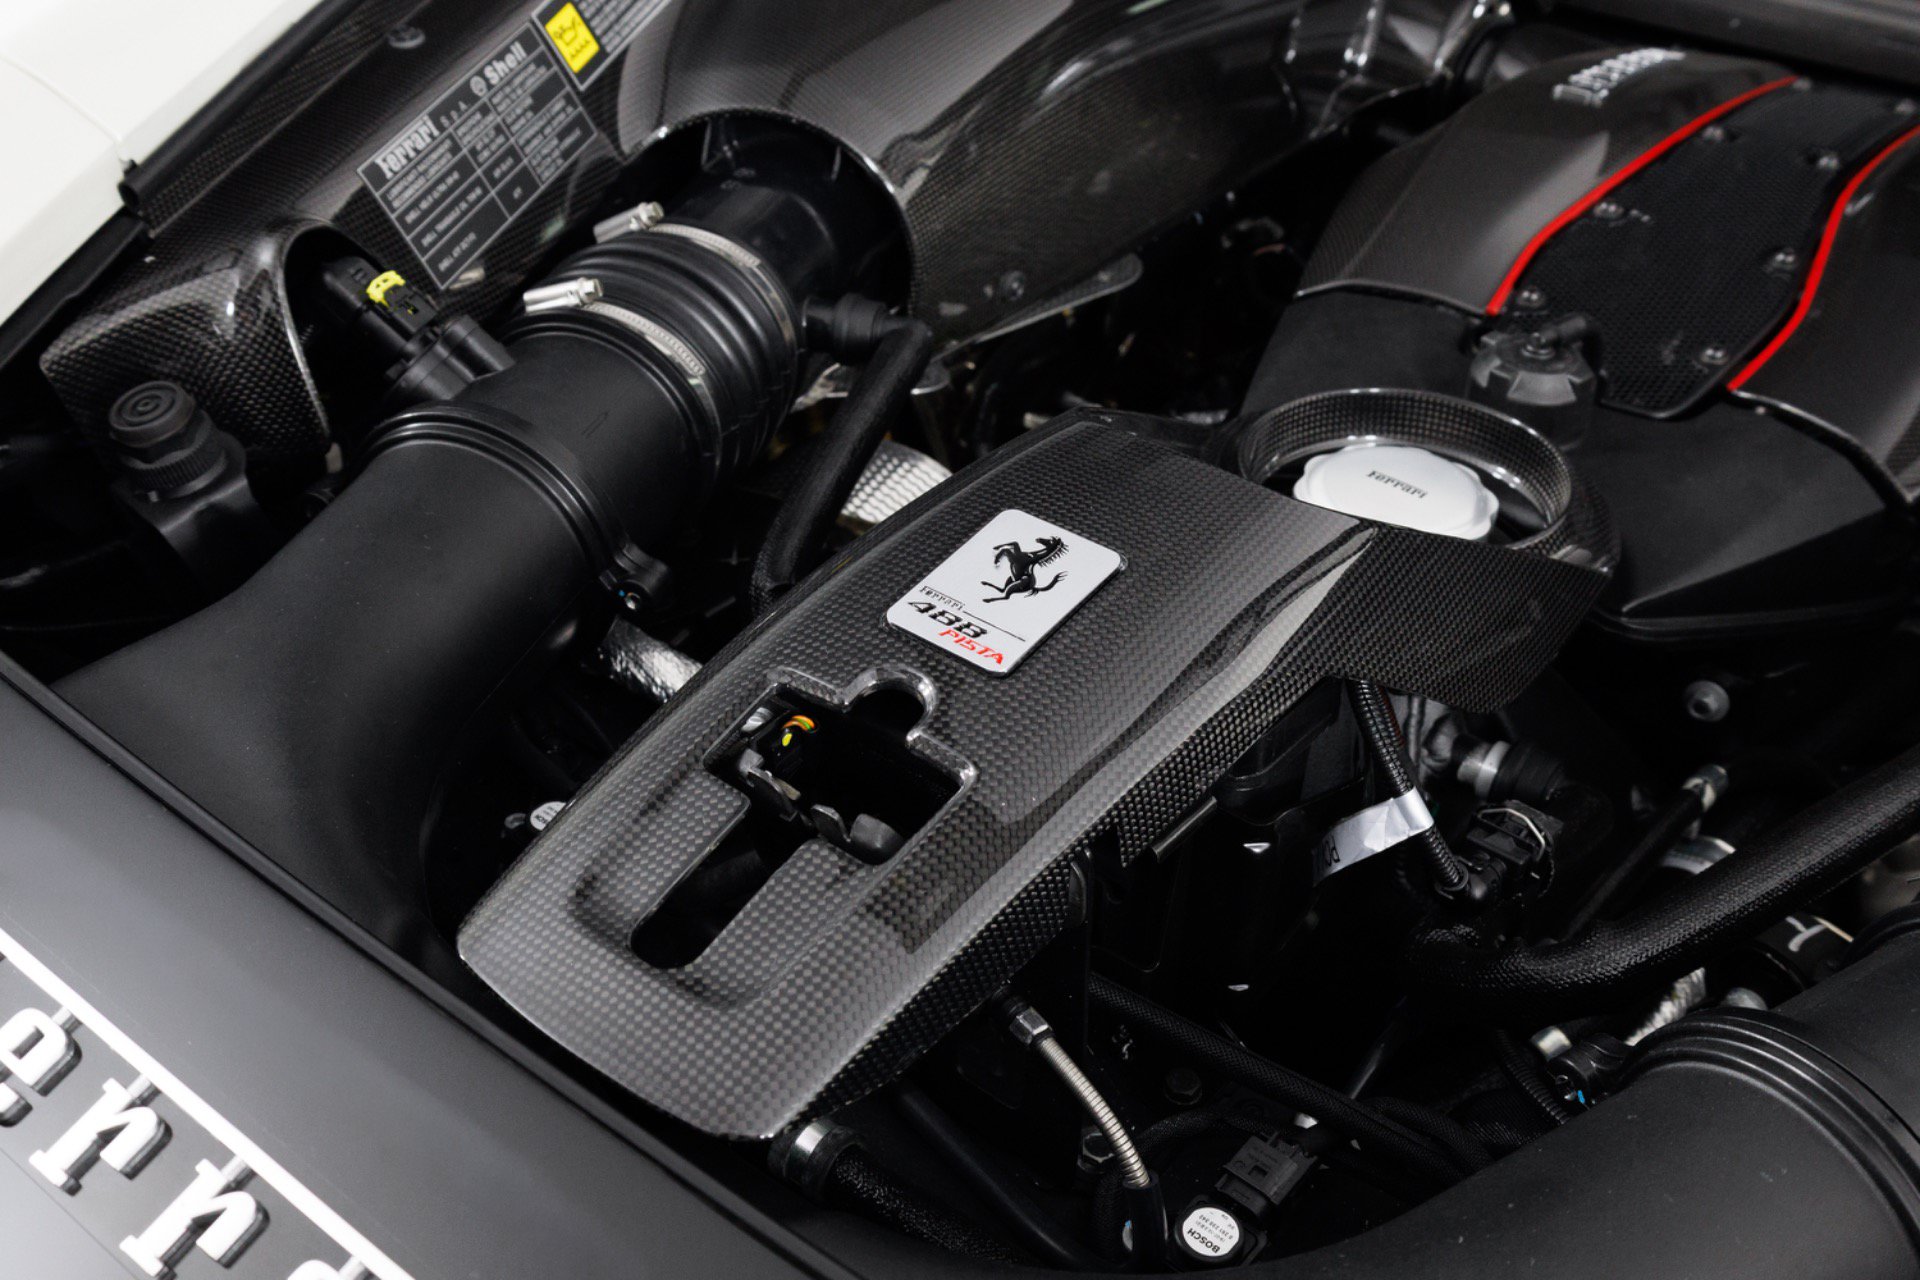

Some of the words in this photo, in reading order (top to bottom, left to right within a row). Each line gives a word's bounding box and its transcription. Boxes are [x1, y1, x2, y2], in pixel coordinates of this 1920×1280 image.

[375, 114, 440, 180] Ferrari
[484, 41, 528, 86] Shell
[1366, 469, 1428, 499] Ferrari
[920, 586, 965, 611] Ferrari
[908, 602, 988, 638] 488
[938, 628, 1005, 665] PISTA
[1187, 1227, 1220, 1253] BOSCH
